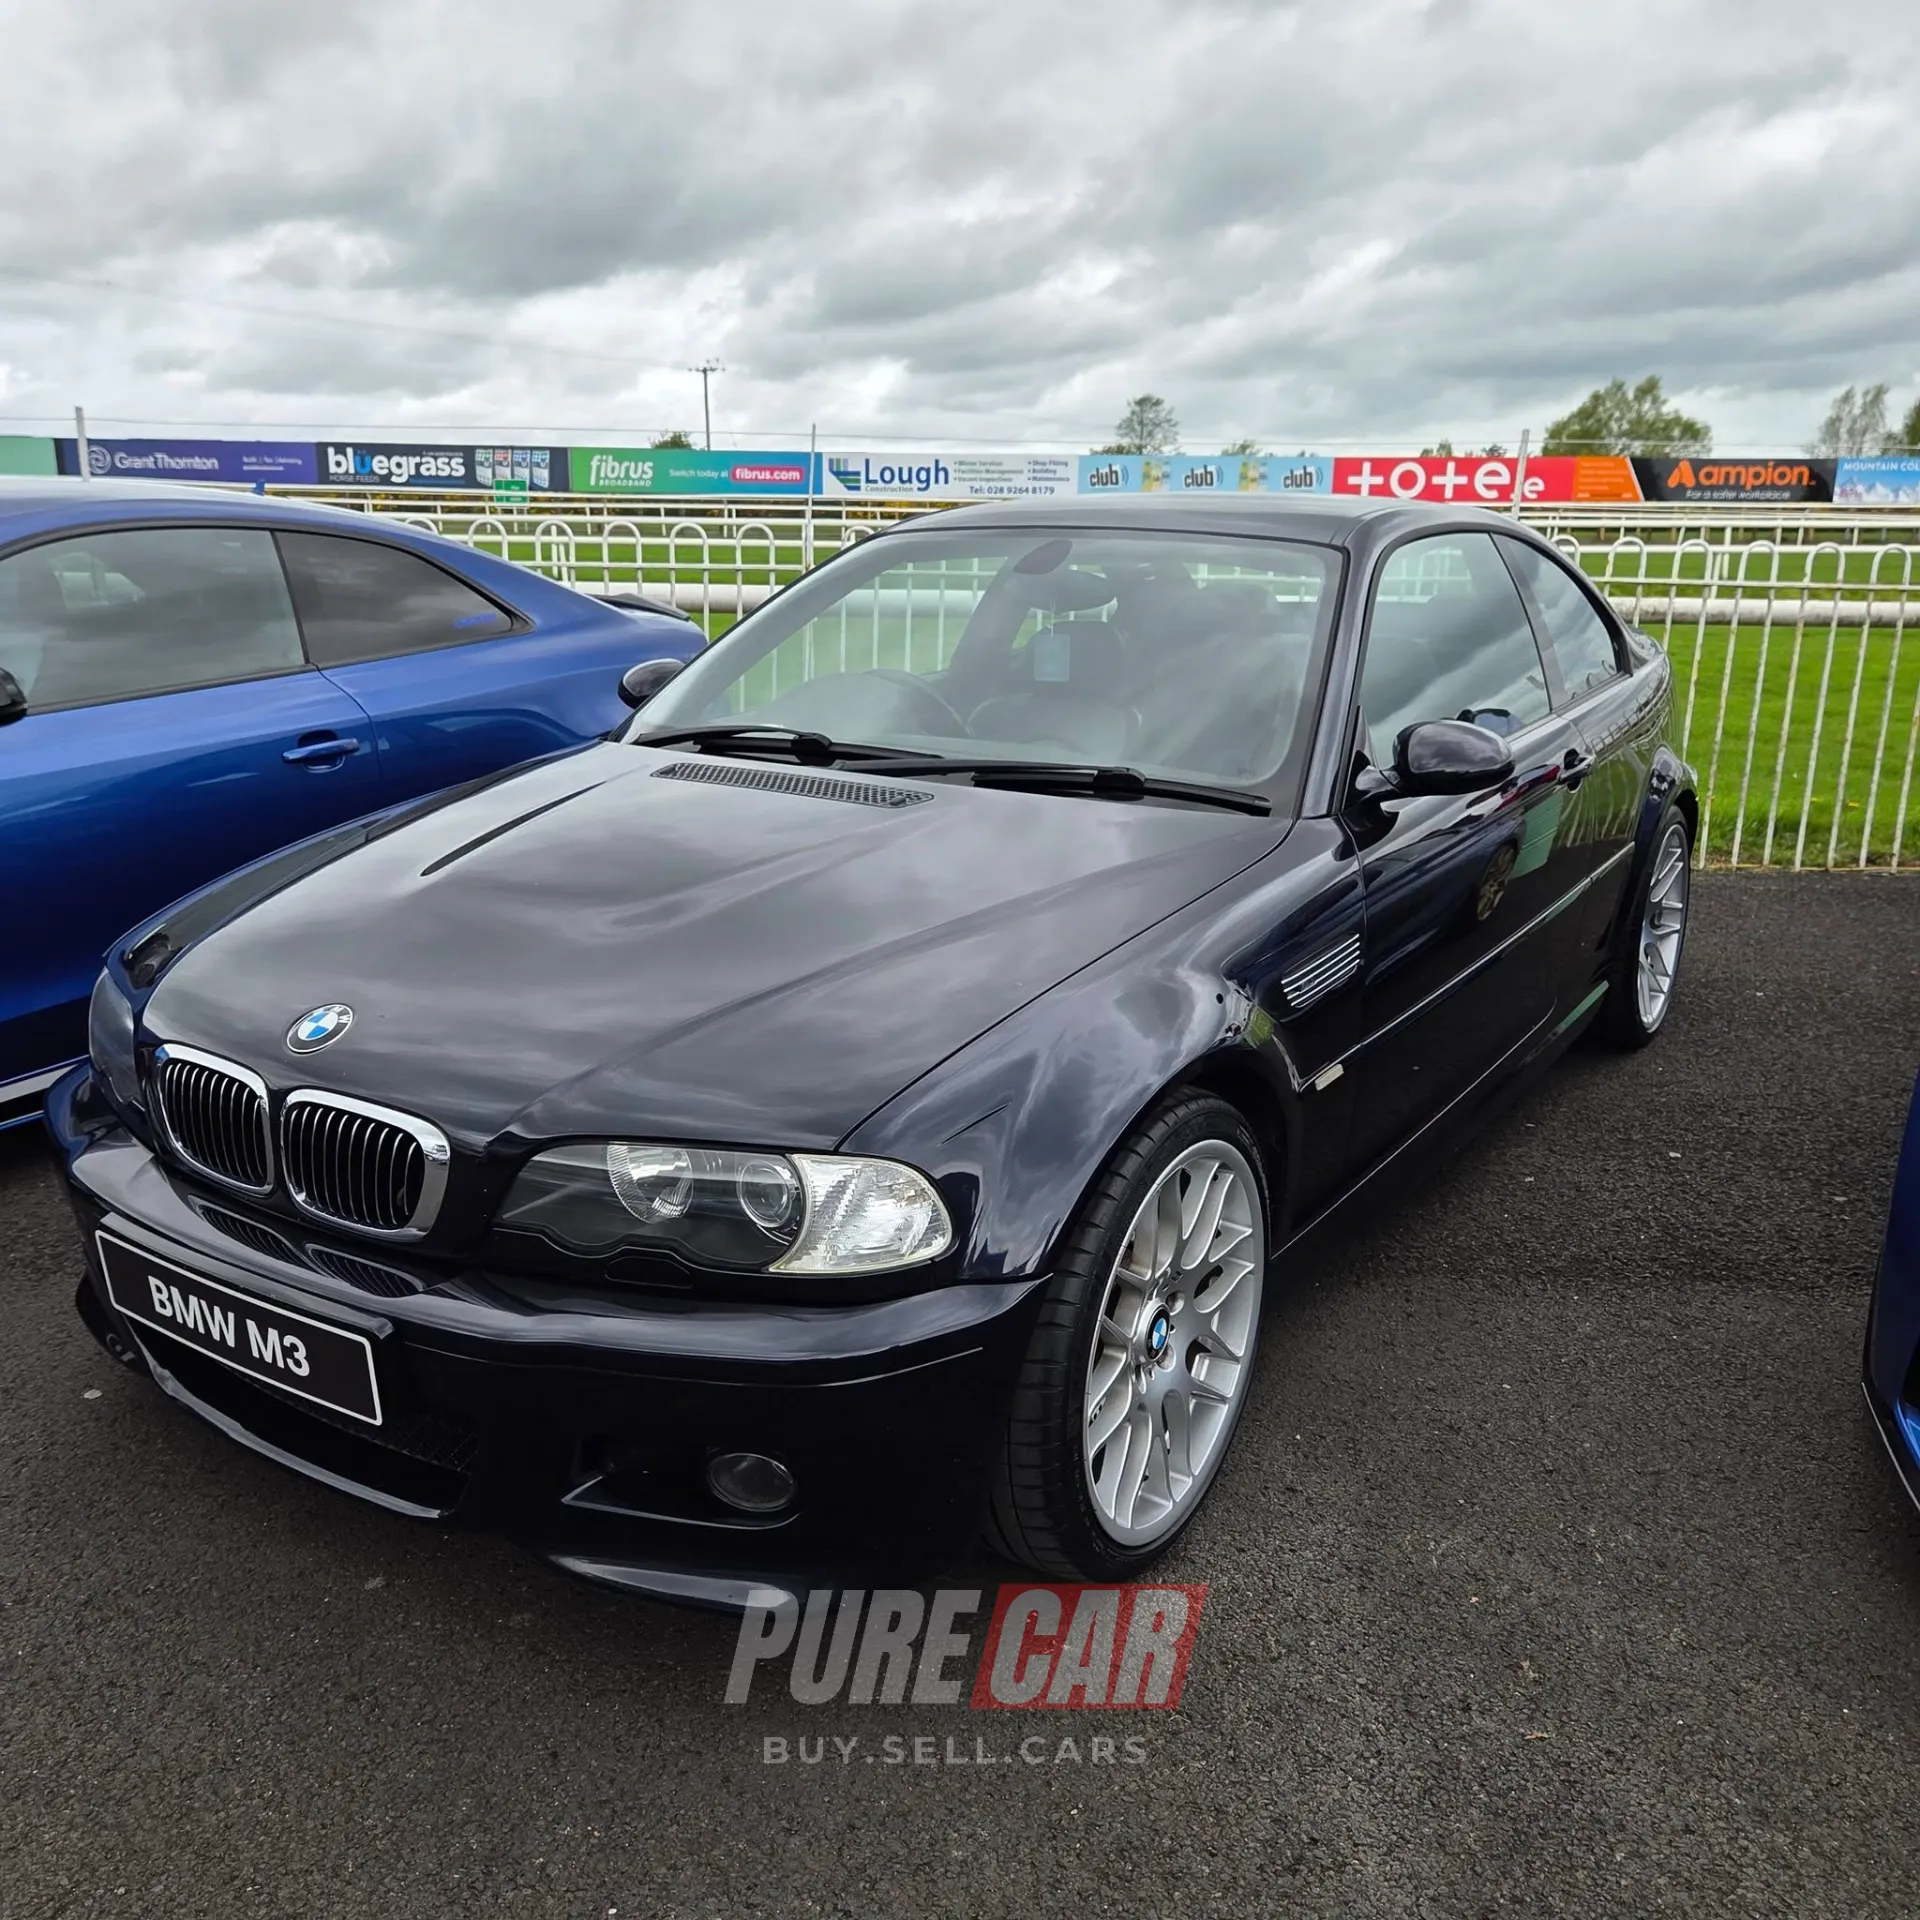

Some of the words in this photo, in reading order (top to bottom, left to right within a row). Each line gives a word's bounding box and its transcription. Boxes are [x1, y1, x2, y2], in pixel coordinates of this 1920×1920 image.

[114, 451, 154, 469] Grant
[154, 452, 219, 470] Thornton
[327, 446, 466, 483] bluegrass
[1843, 461, 1898, 471] MOUNTAIN
[590, 455, 654, 486] fibrus
[668, 469, 695, 477] Switch
[697, 469, 719, 479] today
[735, 467, 800, 480] fibrus.com
[864, 458, 950, 492] Lough
[1089, 464, 1119, 487] club
[1184, 465, 1214, 488] club
[1282, 465, 1313, 488] club
[599, 479, 652, 487] BROADBAND
[865, 486, 914, 494] Construction
[969, 486, 985, 495] Tel:
[987, 486, 1004, 495] 028
[1007, 486, 1029, 495] 9264
[1031, 486, 1055, 495] 8179
[1713, 489, 1737, 500] safer
[1738, 489, 1791, 501] workplace
[148, 1275, 235, 1348] BMW
[245, 1318, 310, 1377] M3
